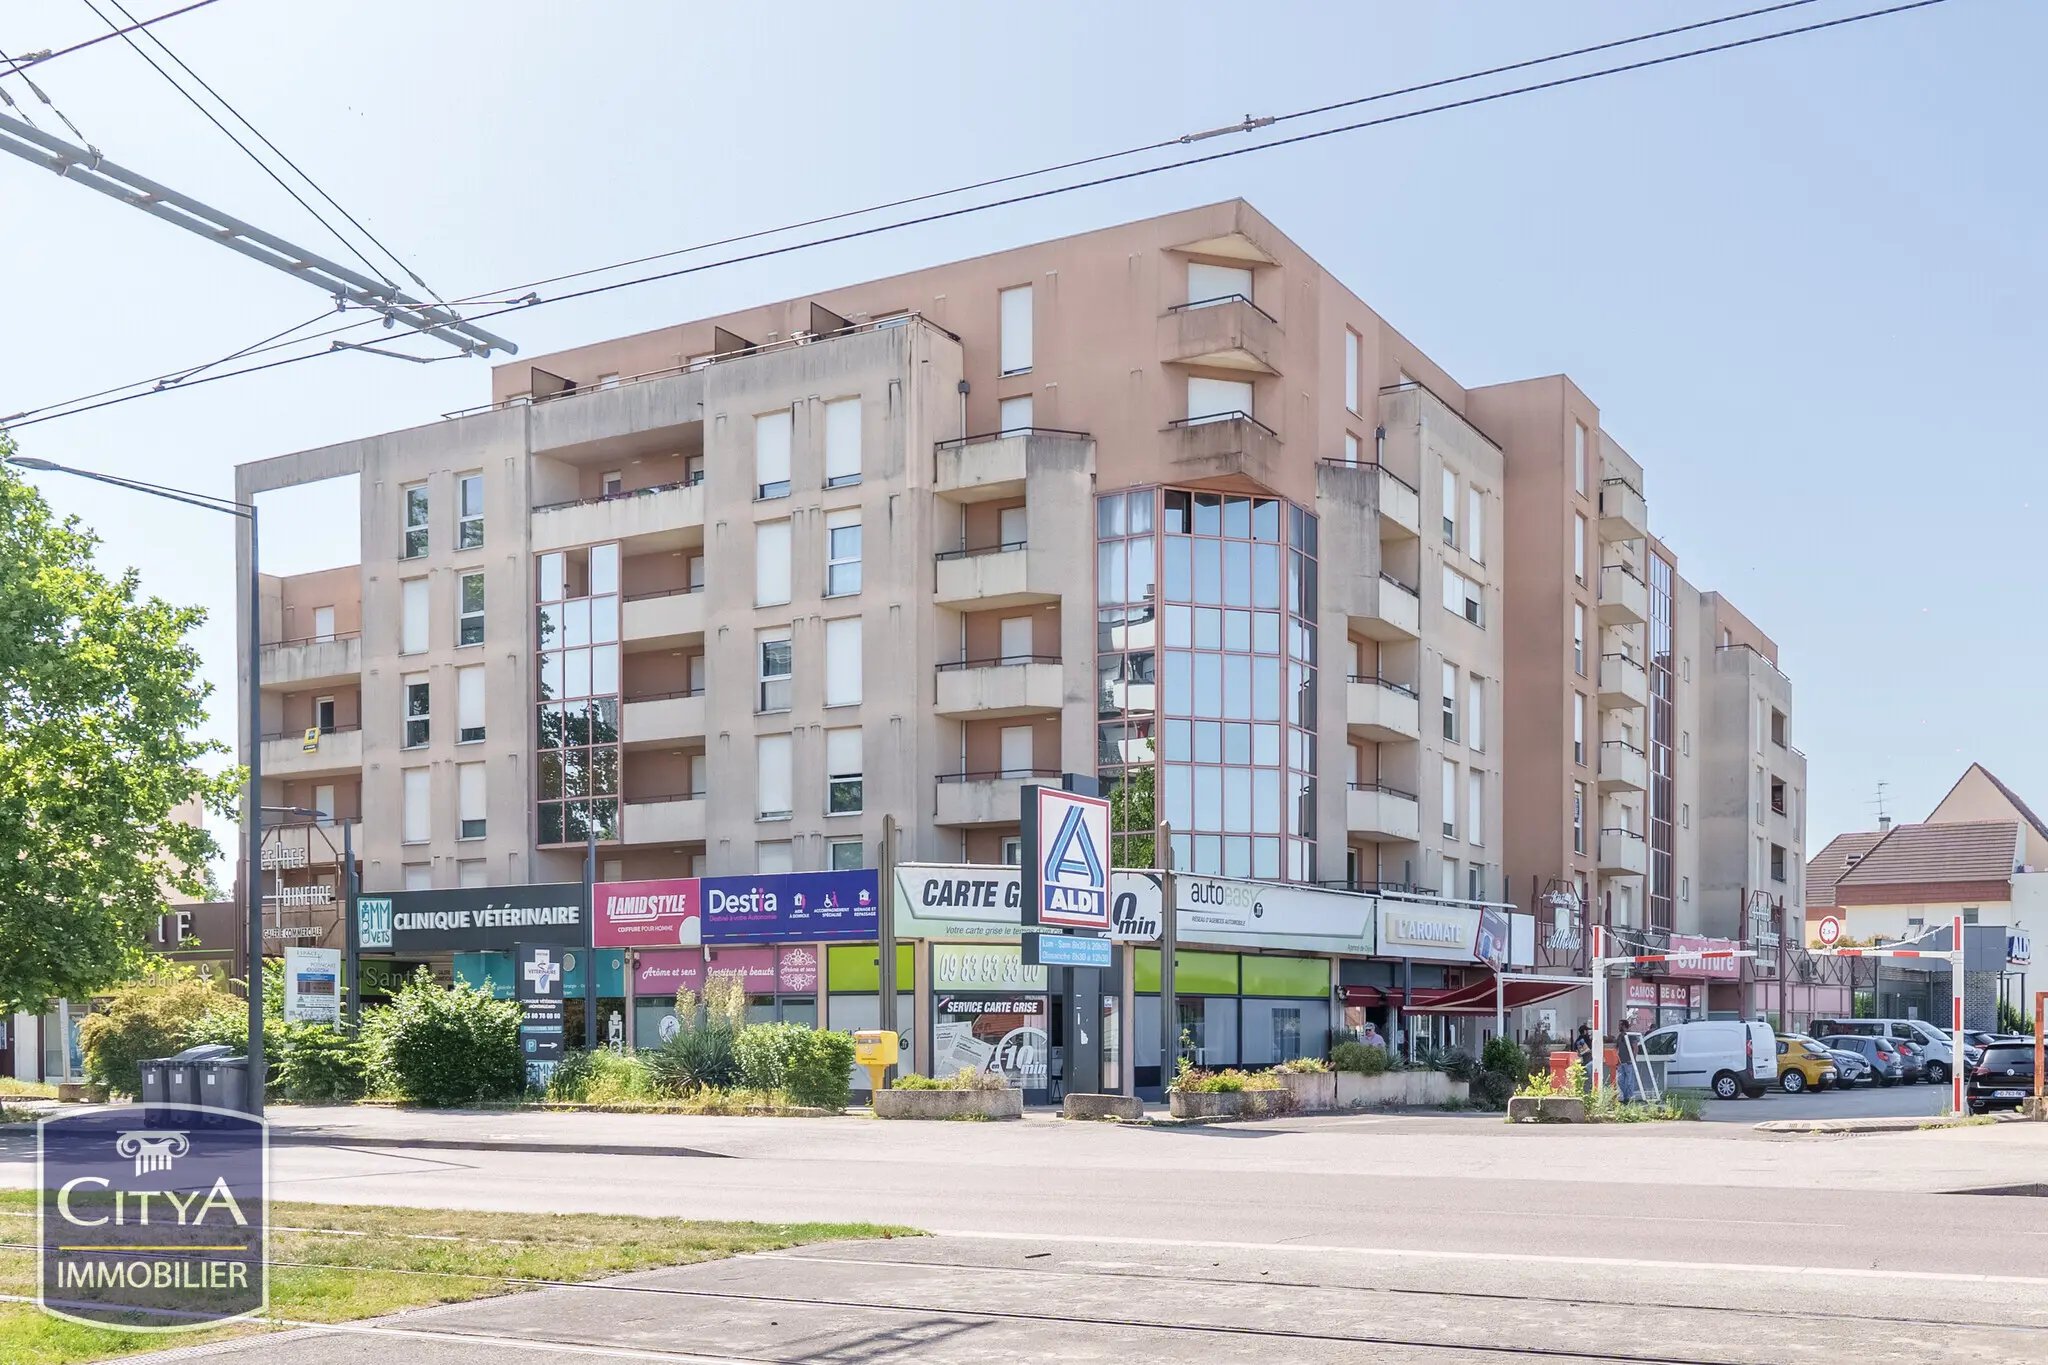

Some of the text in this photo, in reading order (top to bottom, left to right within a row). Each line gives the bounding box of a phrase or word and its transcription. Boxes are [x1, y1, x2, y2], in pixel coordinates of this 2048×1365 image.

[922, 879, 998, 908] CARTE
[708, 888, 776, 914] Destia
[1050, 888, 1099, 914] ALDI
[394, 904, 580, 932] CLINIQUE VÉTÉRINAIRE
[985, 927, 1003, 936] grise
[1118, 916, 1156, 934] min
[1396, 920, 1462, 943] L'AROMATE
[264, 926, 322, 938] GALERIE COMMERCIALE
[370, 930, 390, 943] VETS
[1042, 951, 1070, 960] Dimanche
[642, 966, 670, 979] Arôme
[737, 966, 748, 976] de
[750, 965, 774, 976] beauté
[1671, 989, 1675, 998] &
[1677, 988, 1686, 999] CO
[948, 1002, 1038, 1013] SERVICE CARTE GRISE
[1005, 1045, 1034, 1069] 10
[1020, 1061, 1047, 1074] min
